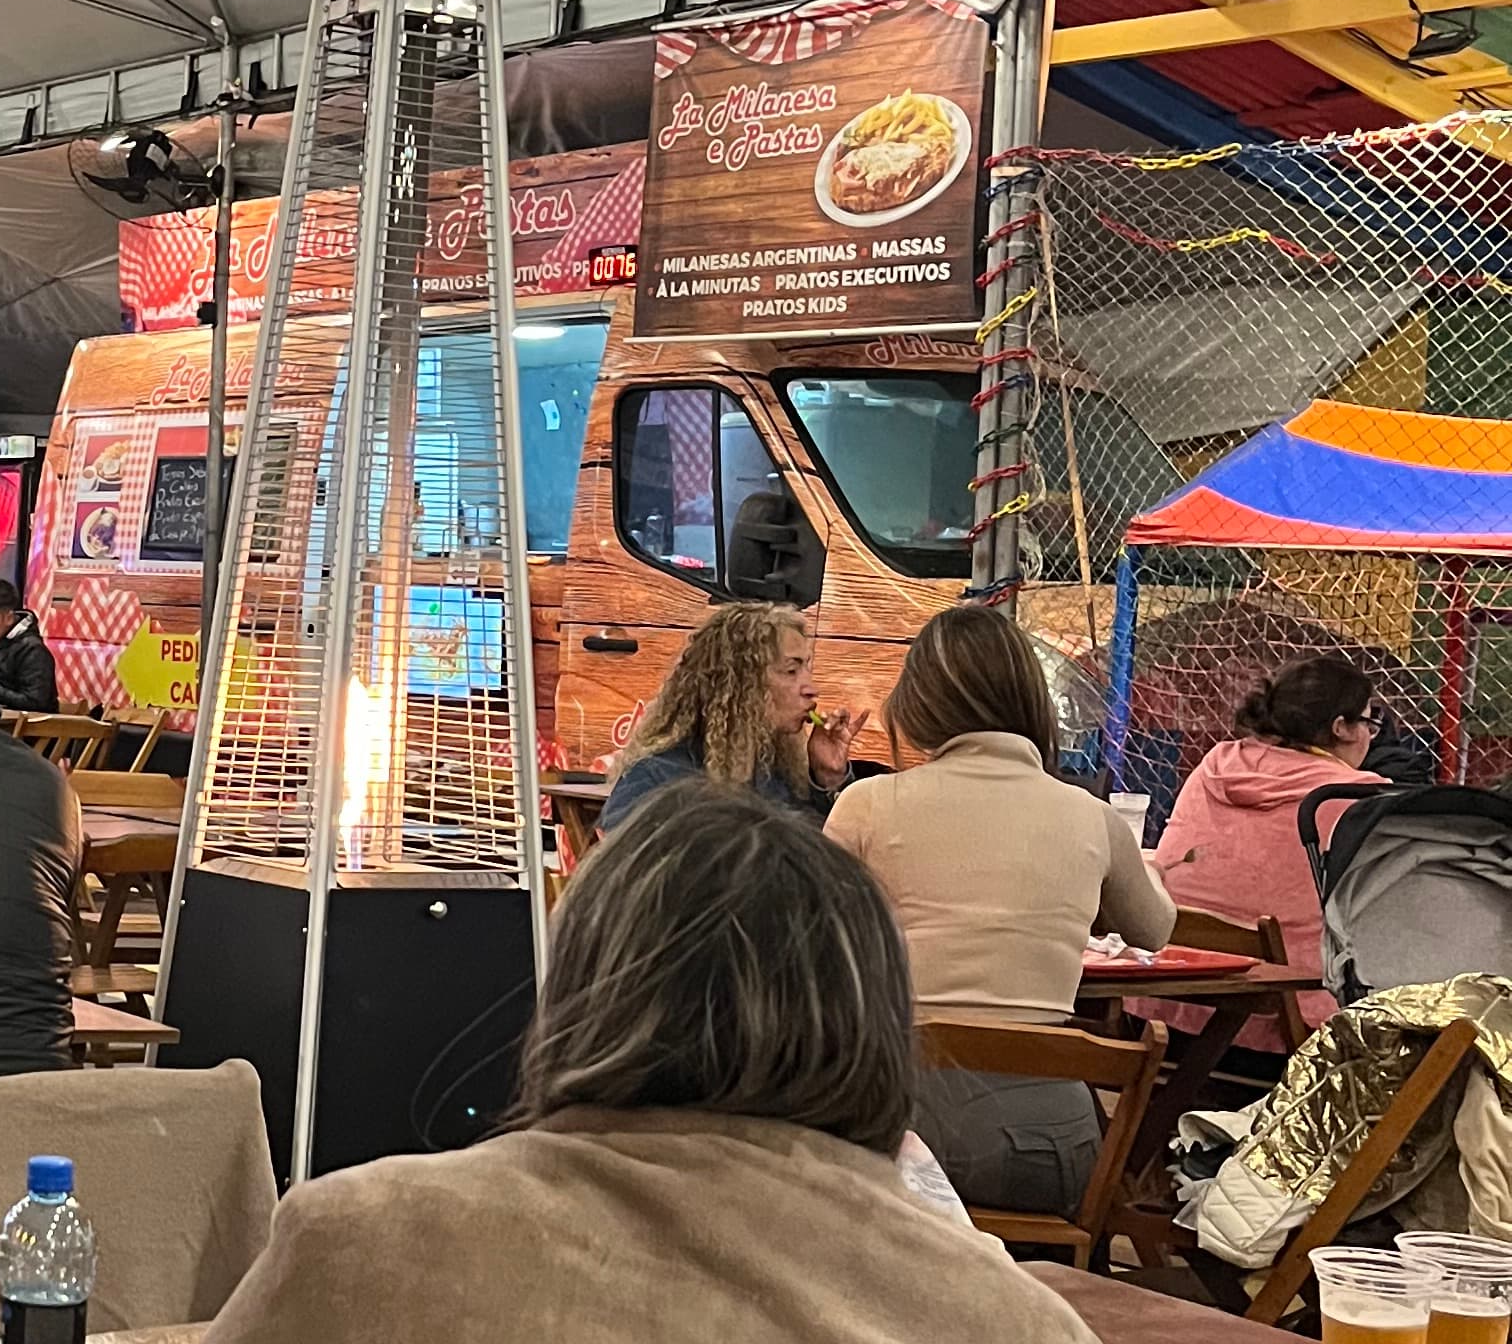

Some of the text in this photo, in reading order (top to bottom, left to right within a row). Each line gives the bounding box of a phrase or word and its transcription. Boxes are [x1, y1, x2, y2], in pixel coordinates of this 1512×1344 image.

[658, 82, 836, 150] La Milanesa
[707, 122, 823, 172] e Pastas
[593, 253, 636, 281] 0076
[663, 236, 946, 274] MILANESAS ARGENTINAS MASSAS
[670, 282, 689, 297] LA
[691, 276, 761, 295] MINUTAS
[775, 271, 839, 291] PRATOS
[841, 262, 951, 287] EXECUTIVOS
[742, 296, 848, 317] PRATOS KIDS
